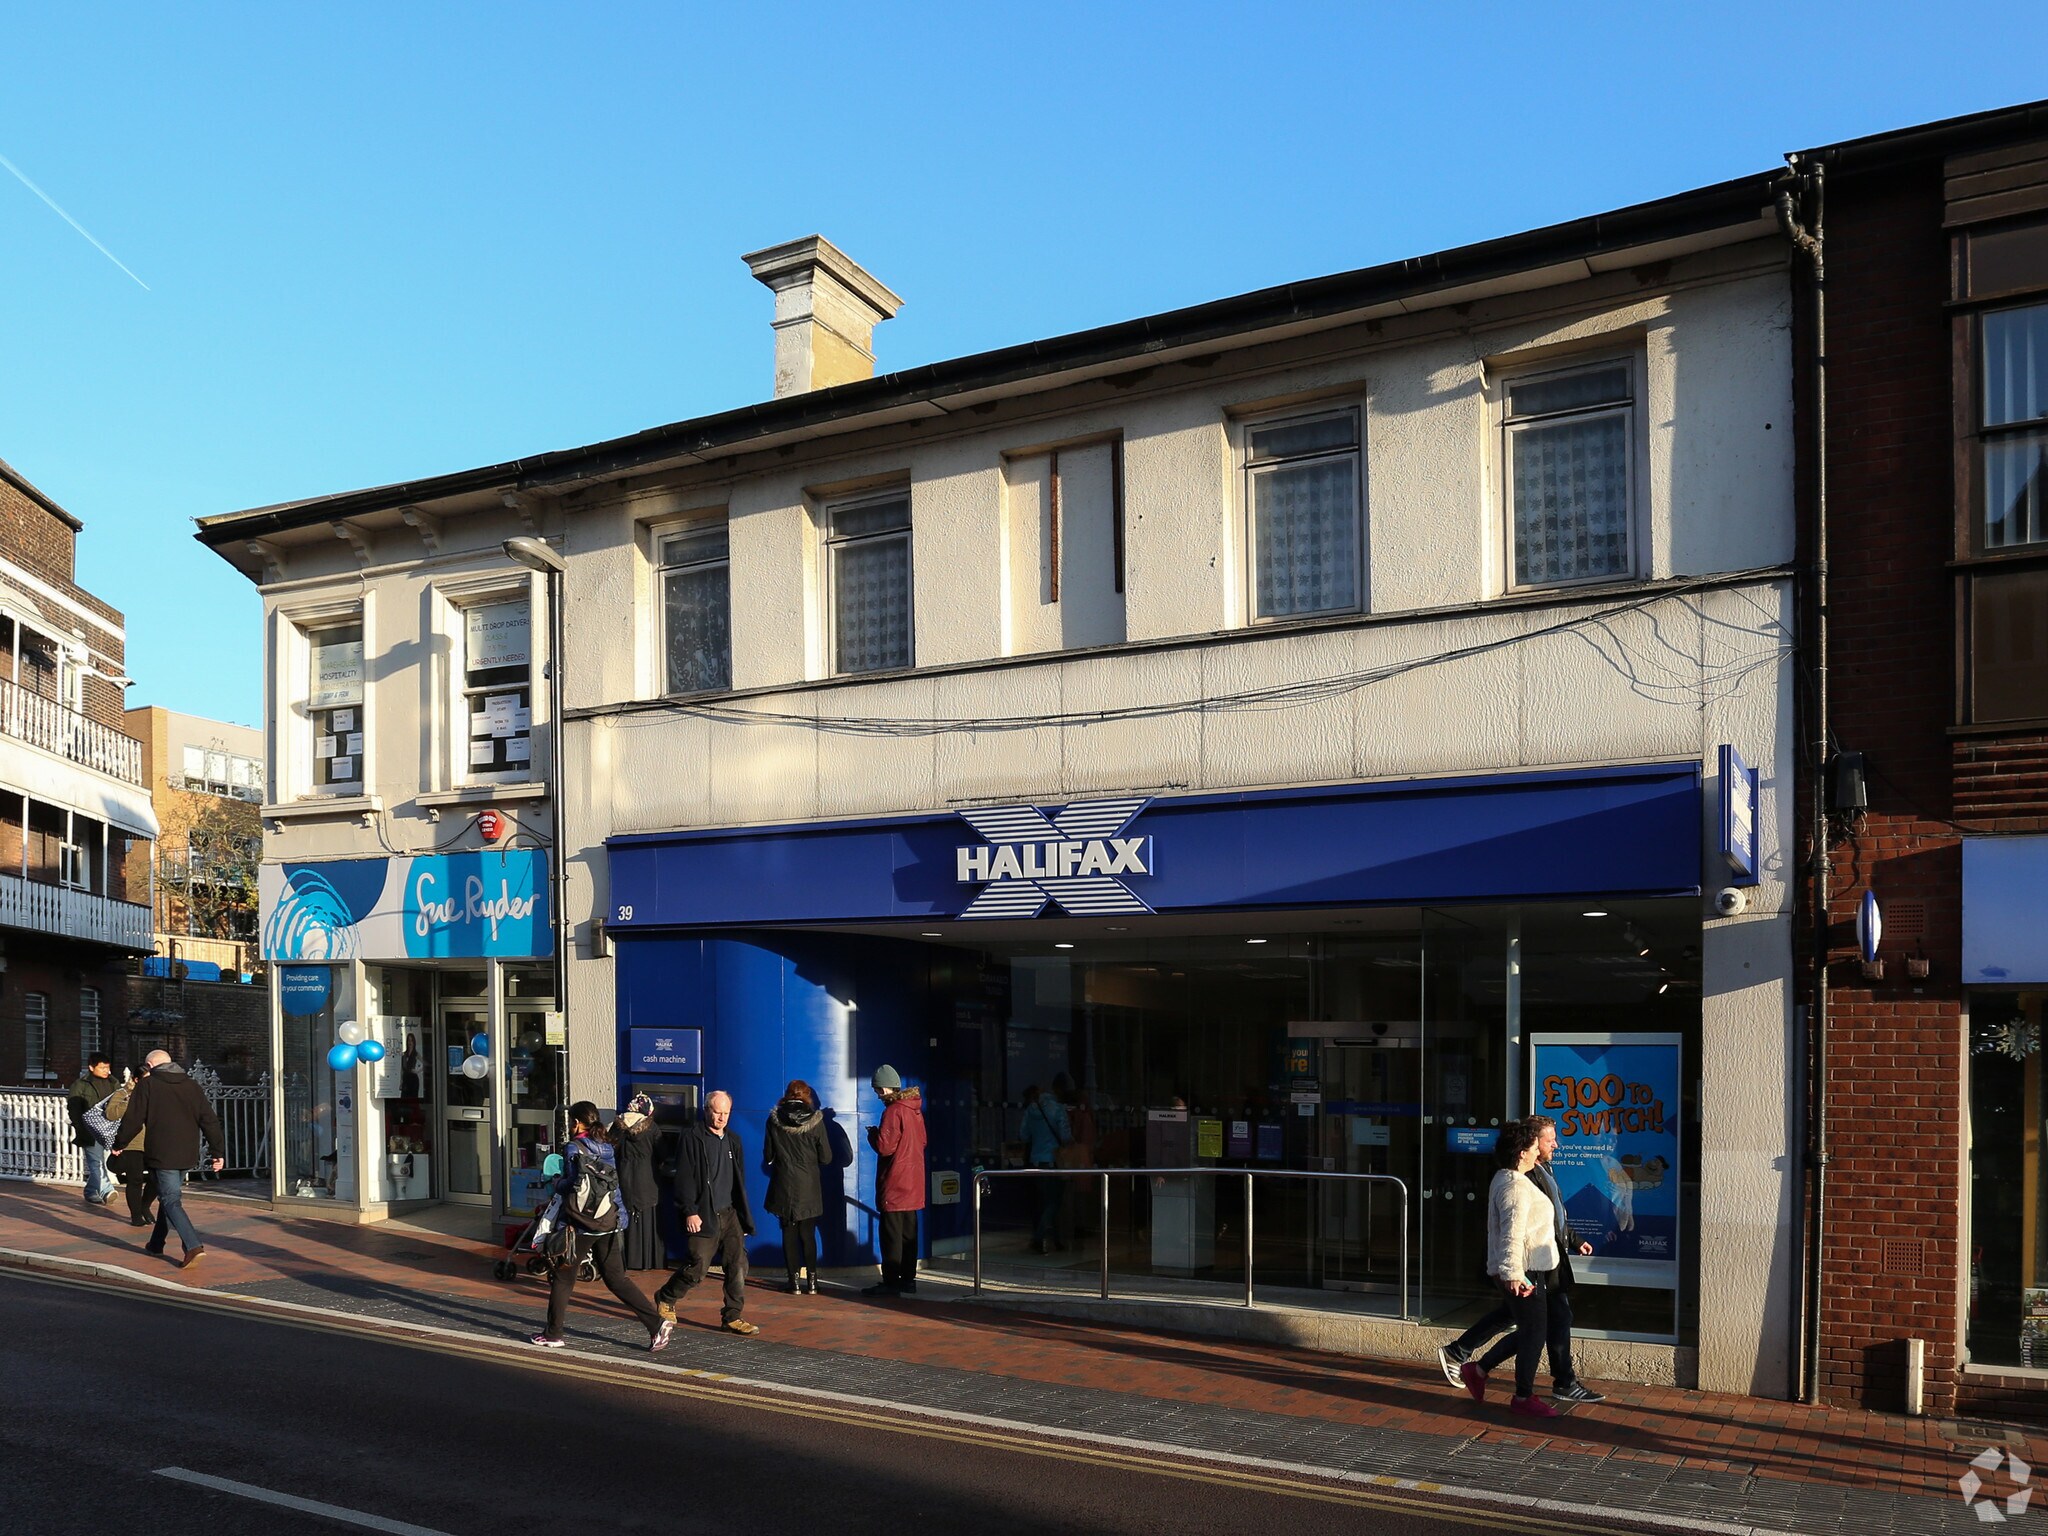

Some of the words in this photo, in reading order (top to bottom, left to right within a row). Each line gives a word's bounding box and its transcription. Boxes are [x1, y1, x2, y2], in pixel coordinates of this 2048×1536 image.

[489, 621, 505, 630] DROP
[472, 656, 502, 665] URGENTLY
[503, 653, 526, 662] NEEDED
[320, 669, 358, 680] HOSPITALITY
[957, 837, 1148, 881] HALIFAX
[415, 872, 464, 937] Sue
[465, 875, 541, 942] Ryder
[618, 905, 633, 921] 39
[286, 974, 308, 983] Providing
[287, 985, 298, 993] your
[298, 984, 325, 993] community
[643, 1054, 658, 1063] cash
[659, 1054, 686, 1064] machine
[1543, 1074, 1625, 1109] £100
[1626, 1083, 1653, 1104] TO
[1562, 1099, 1664, 1136] SWITCH!
[1562, 1144, 1582, 1152] you've
[1563, 1152, 1578, 1160] your
